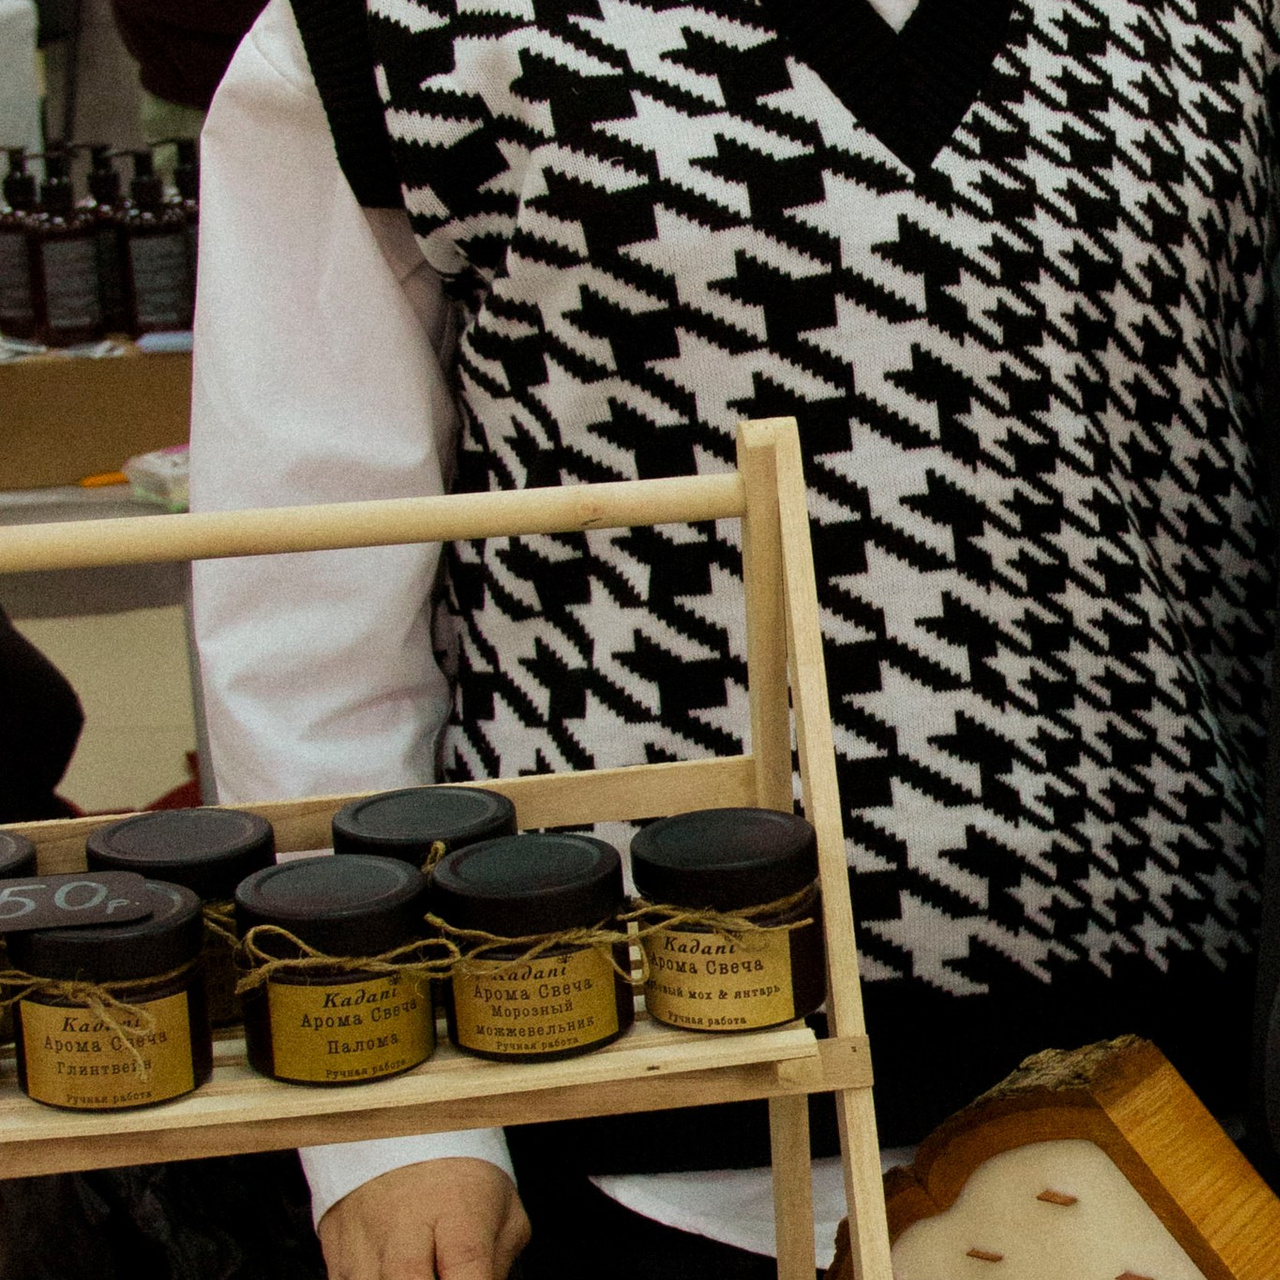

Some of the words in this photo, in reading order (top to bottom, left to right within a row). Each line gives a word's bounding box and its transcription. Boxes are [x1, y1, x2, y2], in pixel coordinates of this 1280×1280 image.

[650, 952, 698, 974] Арома
[706, 959, 764, 975] Свеча
[322, 987, 398, 1009] Kadani
[474, 985, 531, 1002] Арома
[539, 978, 593, 999] Свеча
[688, 987, 713, 1000] мох
[718, 989, 729, 1000] &
[734, 984, 781, 1000] янтарь
[300, 1013, 363, 1030] Арома
[371, 997, 417, 1022] Свеча
[491, 1000, 574, 1019] Морозный
[668, 1010, 704, 1025] Ручная
[707, 1015, 747, 1027] работа
[476, 1016, 595, 1038] можжевельник
[44, 1036, 101, 1054] Арома
[327, 1033, 399, 1055] Палома
[496, 1040, 537, 1052] Ручная
[541, 1037, 579, 1051] работа
[326, 1068, 368, 1079] Ручная
[372, 1058, 407, 1076] работа
[66, 1093, 108, 1106] Ручная
[113, 1091, 152, 1104] работа
